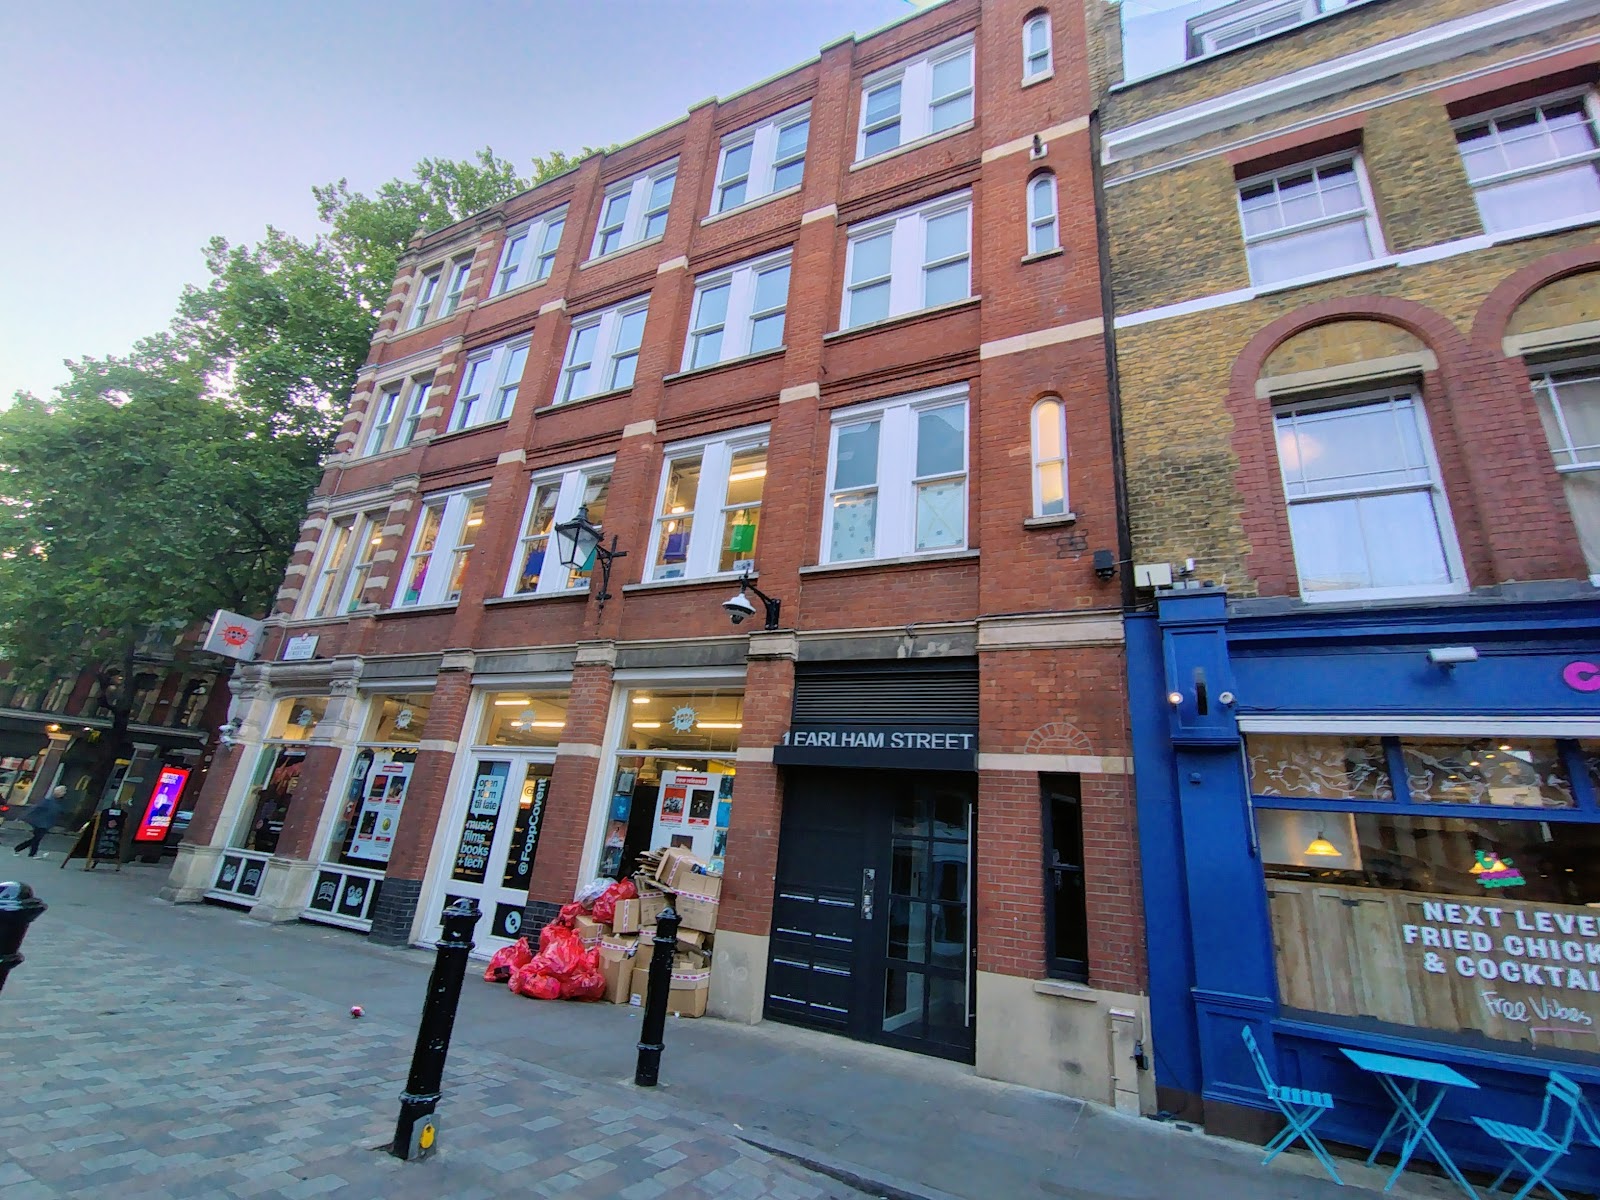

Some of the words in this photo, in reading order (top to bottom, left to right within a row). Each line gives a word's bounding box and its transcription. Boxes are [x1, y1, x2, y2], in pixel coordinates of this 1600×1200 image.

[782, 731, 791, 746] 1
[793, 731, 885, 748] EARLHAM
[890, 732, 974, 750] STREET
[477, 789, 497, 798] 10m
[482, 800, 497, 810] late
[465, 819, 494, 831] music
[463, 830, 486, 843] films
[460, 842, 489, 857] books
[1422, 900, 1504, 928] NEXT
[1514, 909, 1600, 937] LEVE
[1402, 924, 1494, 952] FRIED
[1423, 951, 1447, 974] &
[1480, 989, 1531, 1023] Free
[1528, 996, 1592, 1025] Vibes
